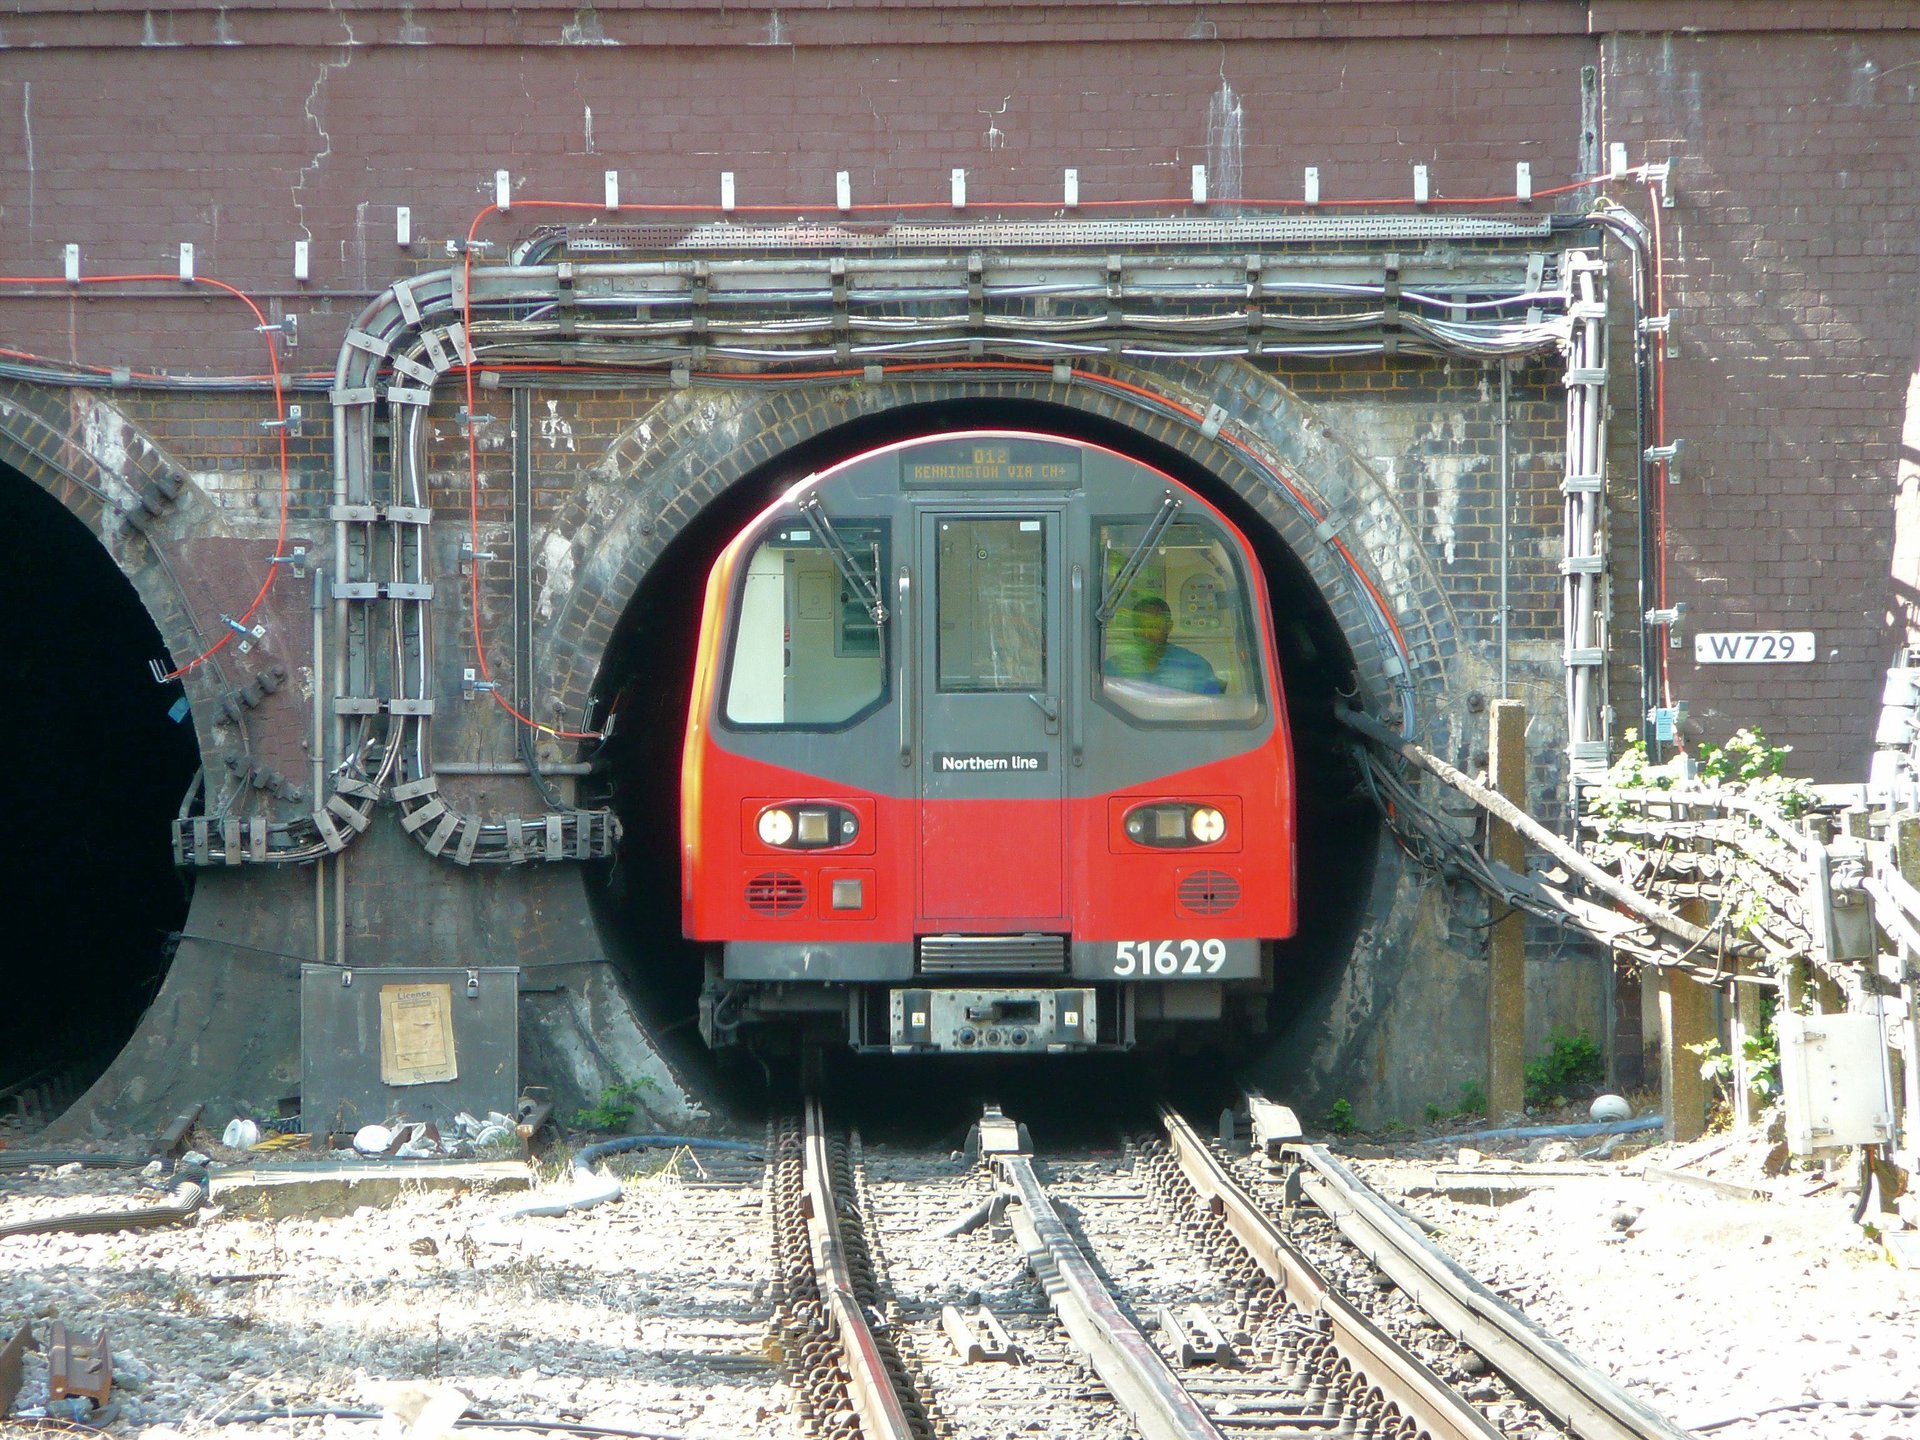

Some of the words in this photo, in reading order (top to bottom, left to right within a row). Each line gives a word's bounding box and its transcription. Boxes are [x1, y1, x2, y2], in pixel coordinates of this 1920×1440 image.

[914, 465, 999, 479] KENNINGTON
[1007, 465, 1033, 478] VIA
[1710, 635, 1795, 660] W729
[942, 756, 1008, 770] Northern
[1011, 755, 1038, 769] line
[1113, 938, 1227, 976] 51629
[397, 990, 432, 1001] Licence
